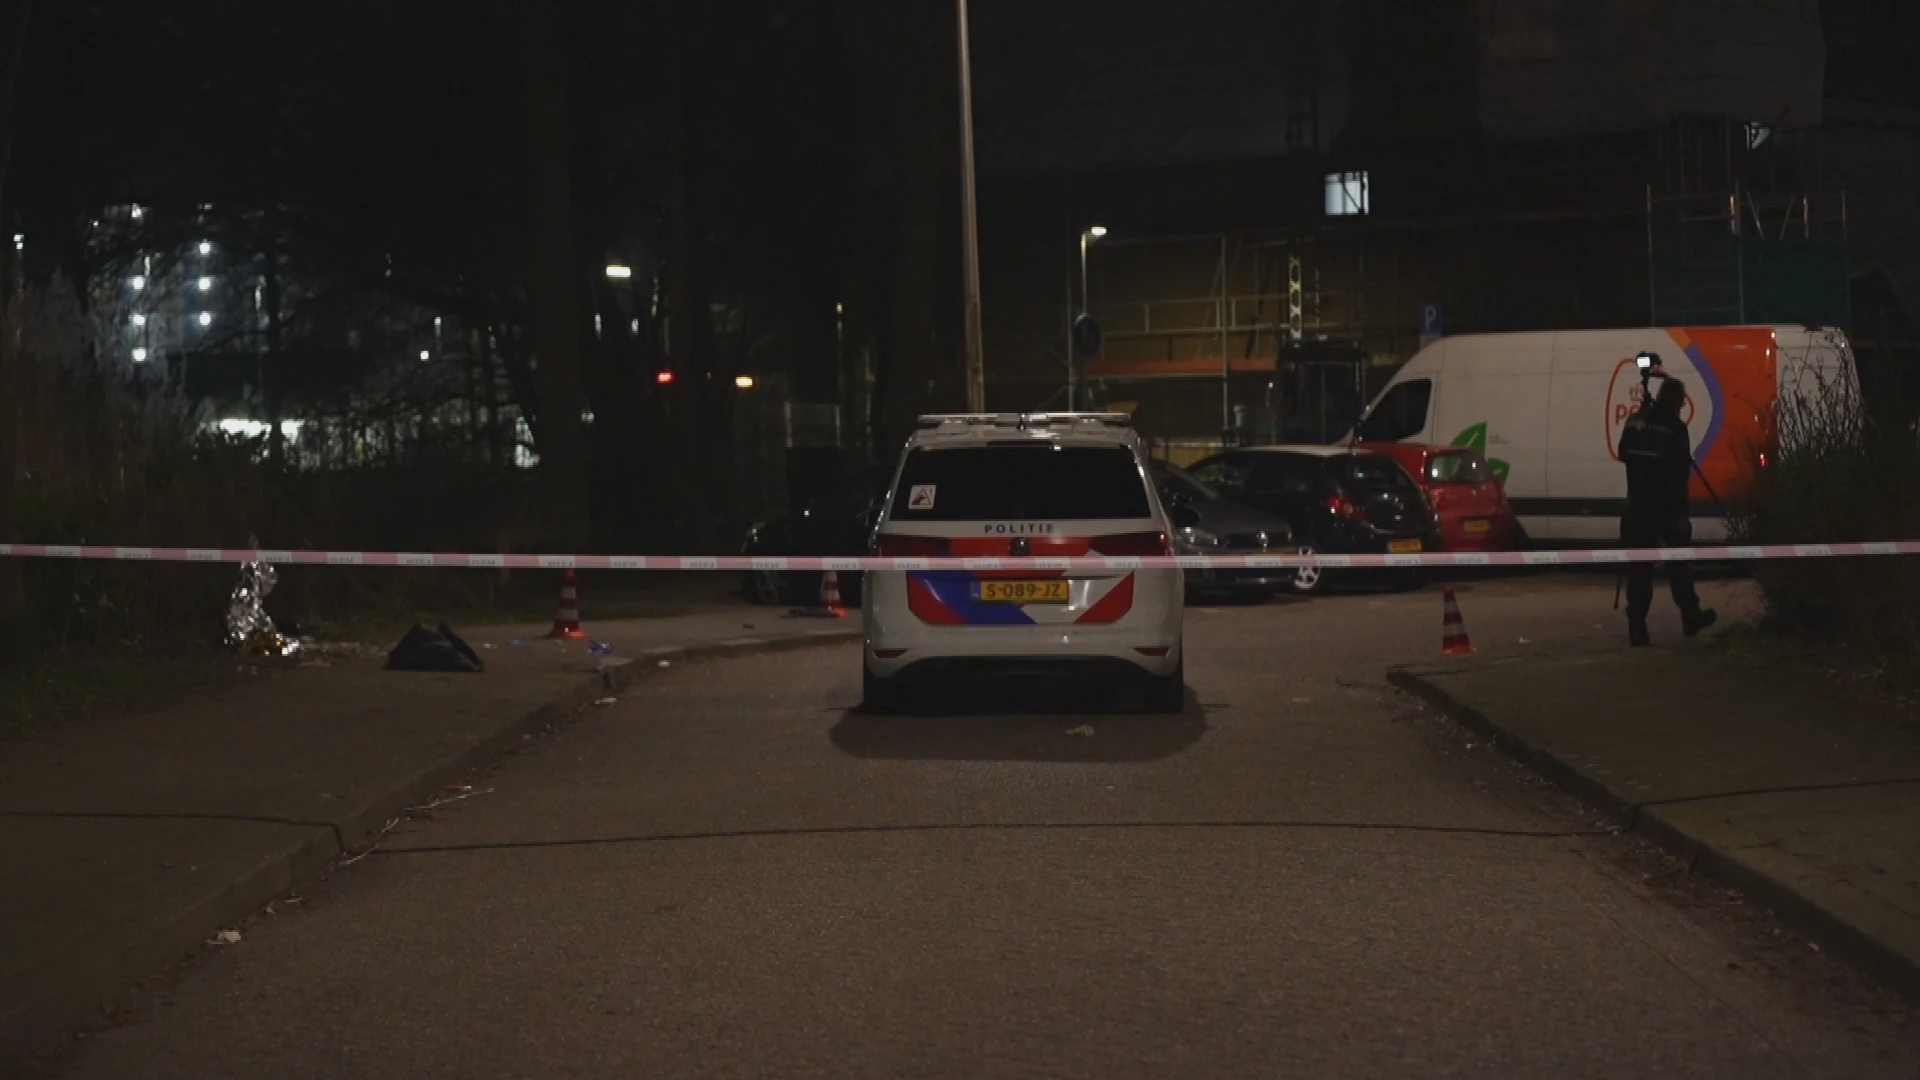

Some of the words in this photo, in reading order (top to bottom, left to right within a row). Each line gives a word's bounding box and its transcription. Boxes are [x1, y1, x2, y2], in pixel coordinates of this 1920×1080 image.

[1424, 305, 1437, 330] P
[984, 523, 1054, 534] POLITIE
[986, 583, 1061, 597] S-089-JZ
